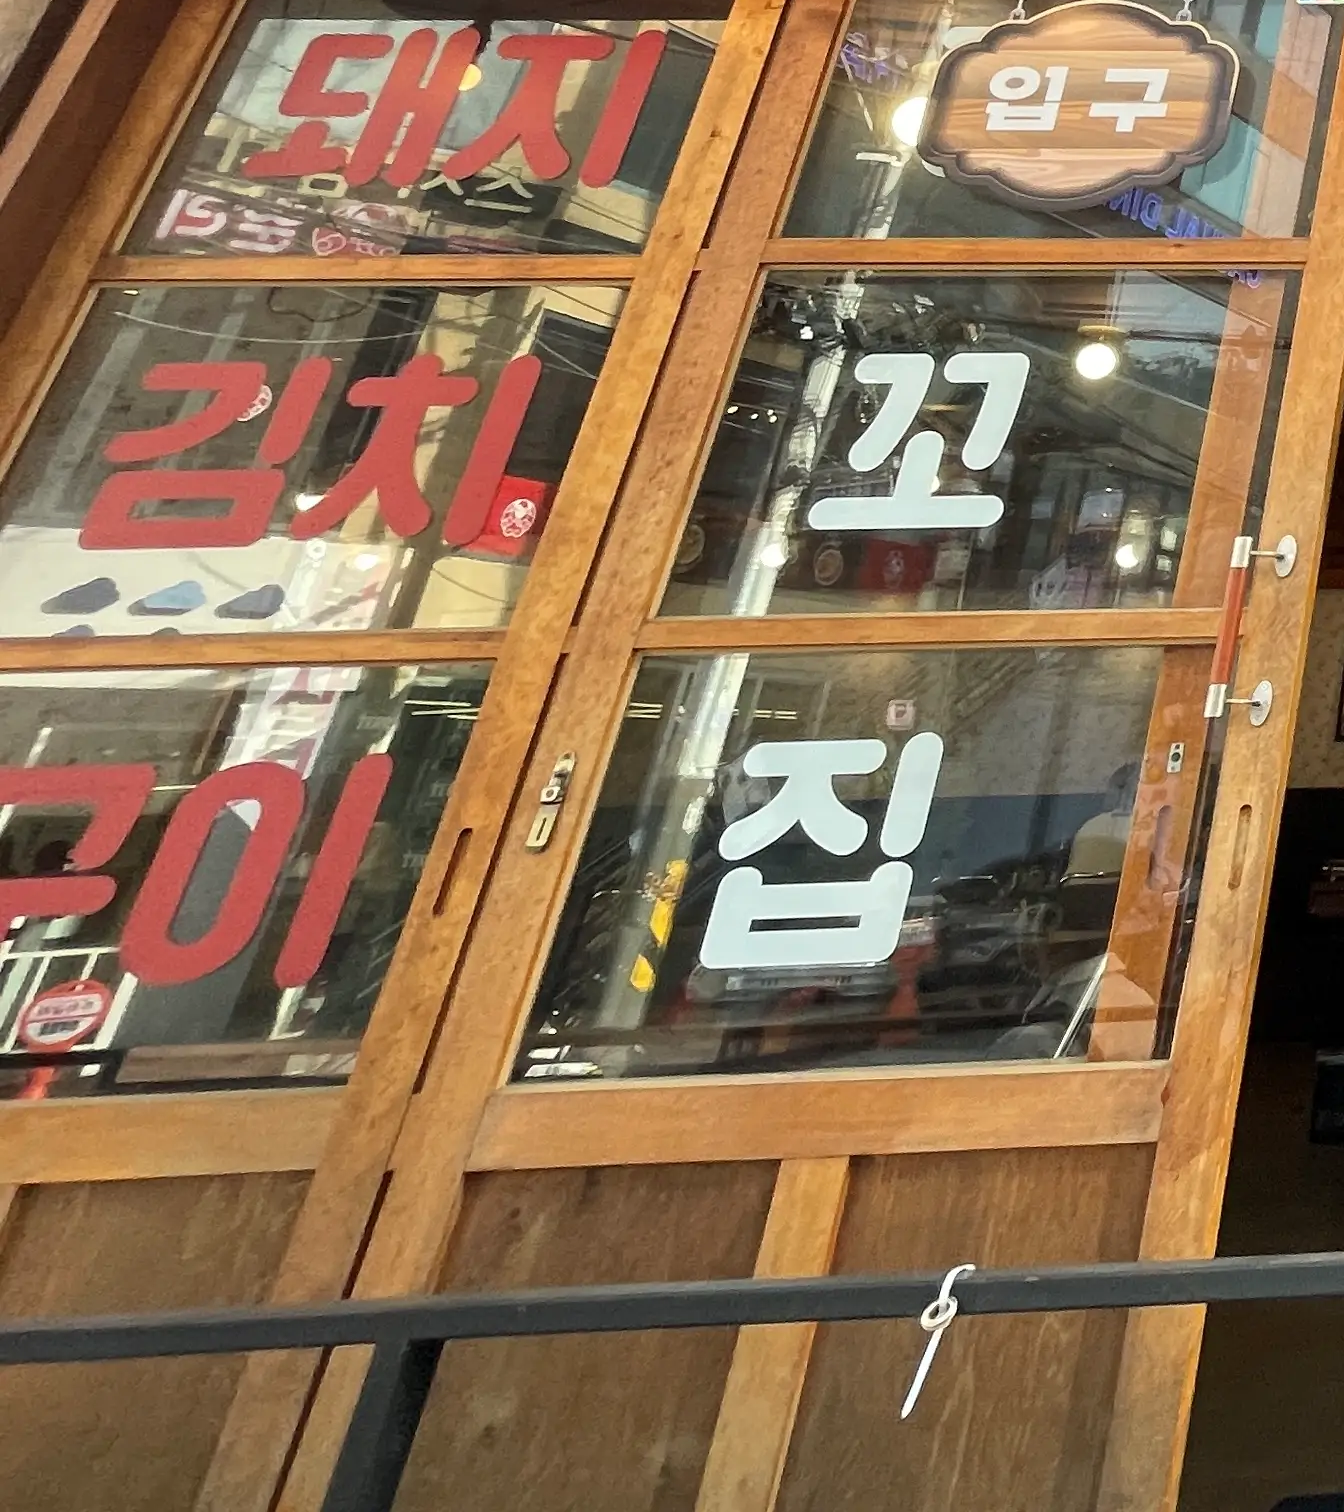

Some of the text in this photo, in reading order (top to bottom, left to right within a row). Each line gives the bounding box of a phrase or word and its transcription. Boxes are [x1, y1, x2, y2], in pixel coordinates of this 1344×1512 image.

[242, 26, 668, 188] 돼지
[984, 64, 1170, 133] 입구
[80, 354, 544, 549] 김치
[699, 352, 1030, 970] 꼬 집
[0, 752, 394, 989] 구이
